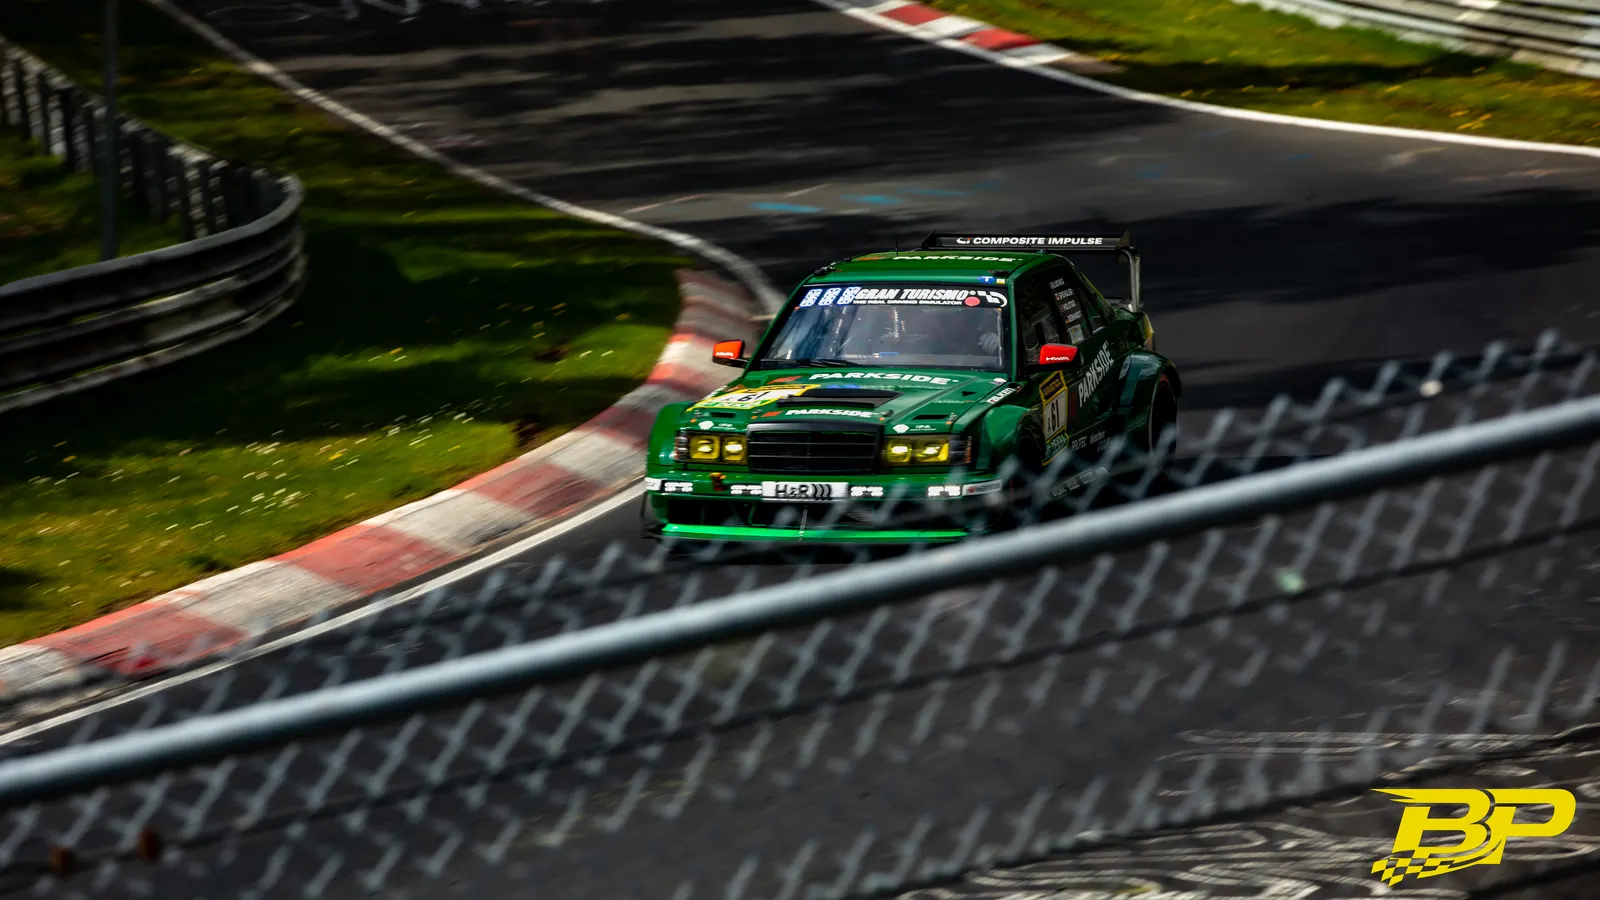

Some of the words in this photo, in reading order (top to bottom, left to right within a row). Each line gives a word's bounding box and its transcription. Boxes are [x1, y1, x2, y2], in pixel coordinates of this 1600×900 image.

[973, 237, 1046, 246] COMPOSITE
[1047, 237, 1103, 245] IMPULSE
[893, 255, 1016, 263] PARKSIDE
[854, 288, 900, 300] GRAN
[900, 288, 969, 300] TURISMO
[808, 372, 951, 385] PARKSIDE
[1078, 342, 1115, 408] PARKSIDE
[785, 409, 873, 418] PARKSIDE
